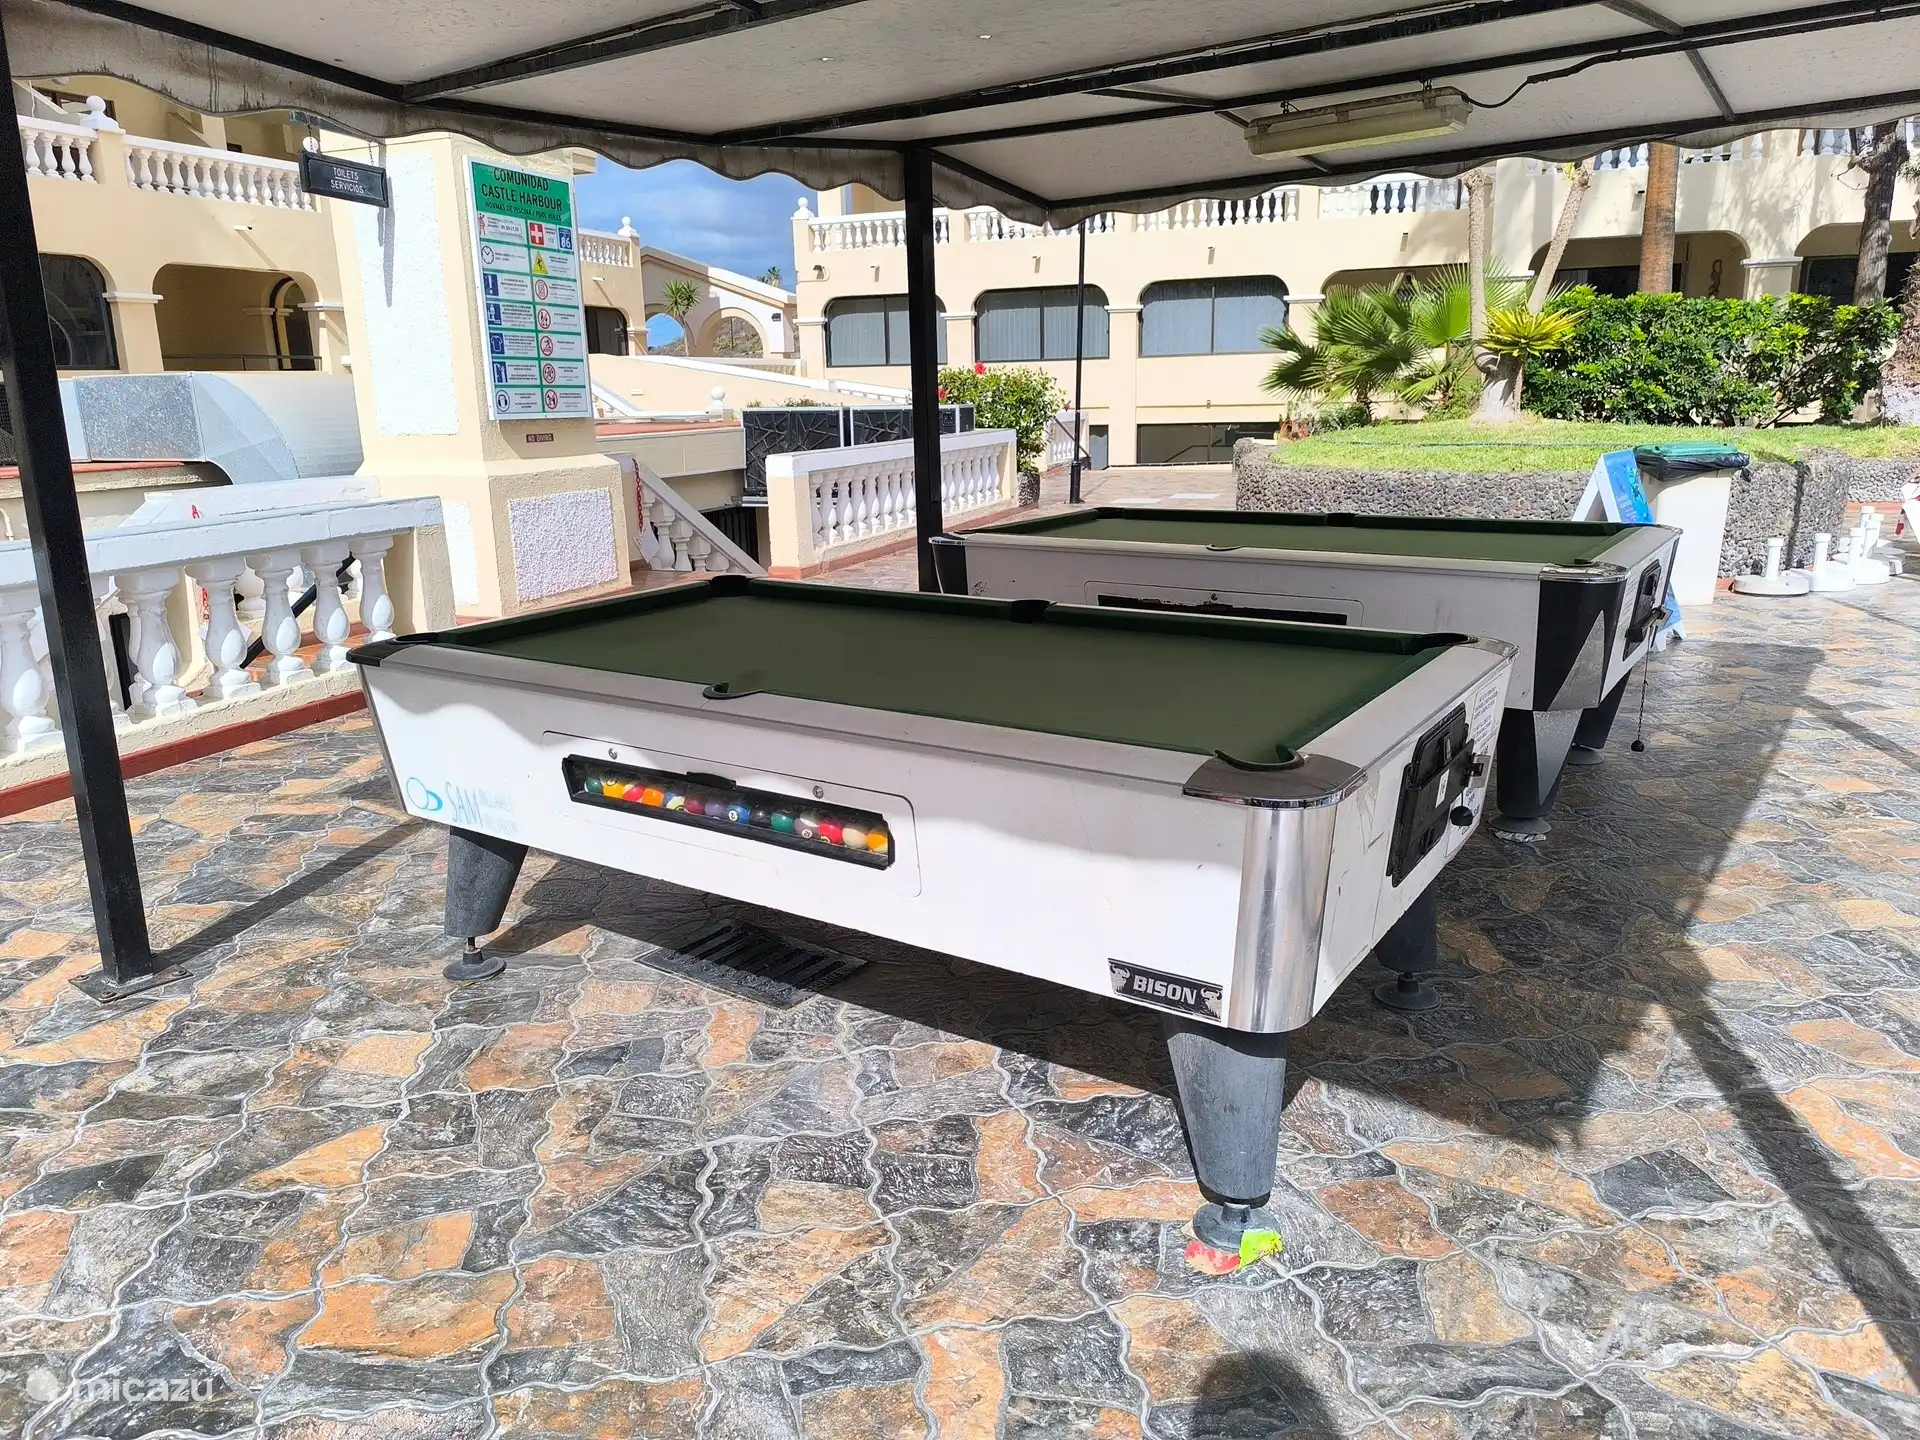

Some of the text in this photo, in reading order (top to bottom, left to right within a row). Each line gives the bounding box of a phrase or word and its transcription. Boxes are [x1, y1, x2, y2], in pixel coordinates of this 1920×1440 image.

[333, 167, 359, 180] TOILETS
[493, 168, 548, 191] COMUNIDAD
[330, 180, 364, 194] SERVICIOS
[481, 183, 563, 211] CASTLE HARBOUR
[514, 206, 533, 216] PISCINA
[535, 210, 547, 219] POOL
[561, 236, 571, 248] 86
[527, 434, 552, 442] NO DIVING
[446, 782, 483, 828] SAM
[1132, 974, 1198, 1005] BISON
